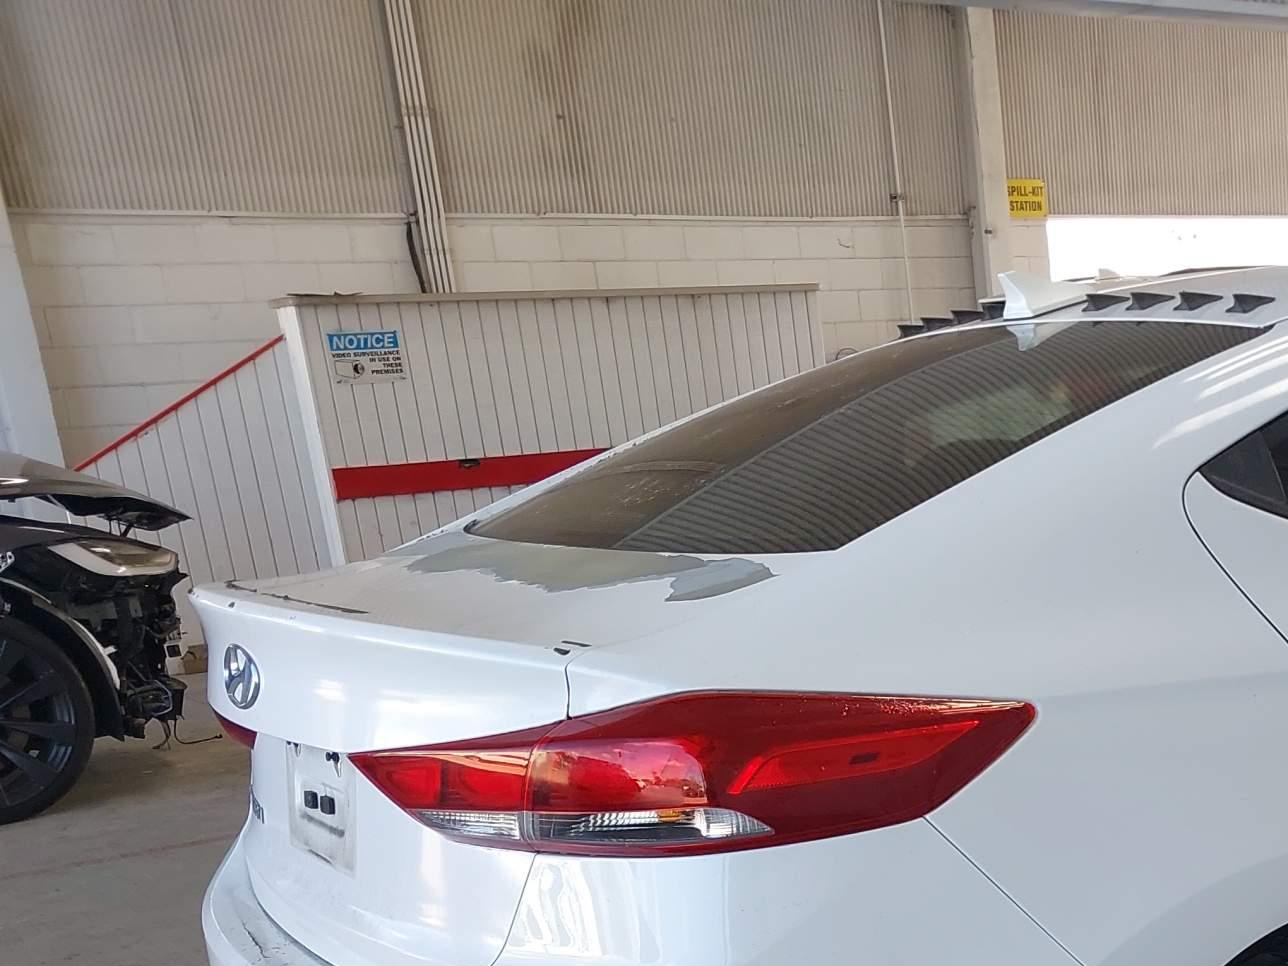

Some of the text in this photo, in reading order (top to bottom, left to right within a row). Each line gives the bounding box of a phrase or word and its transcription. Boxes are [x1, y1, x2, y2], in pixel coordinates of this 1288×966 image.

[1009, 200, 1042, 212] STATION
[332, 333, 394, 350] NOTICE
[353, 350, 401, 358] SURVEILLANCE
